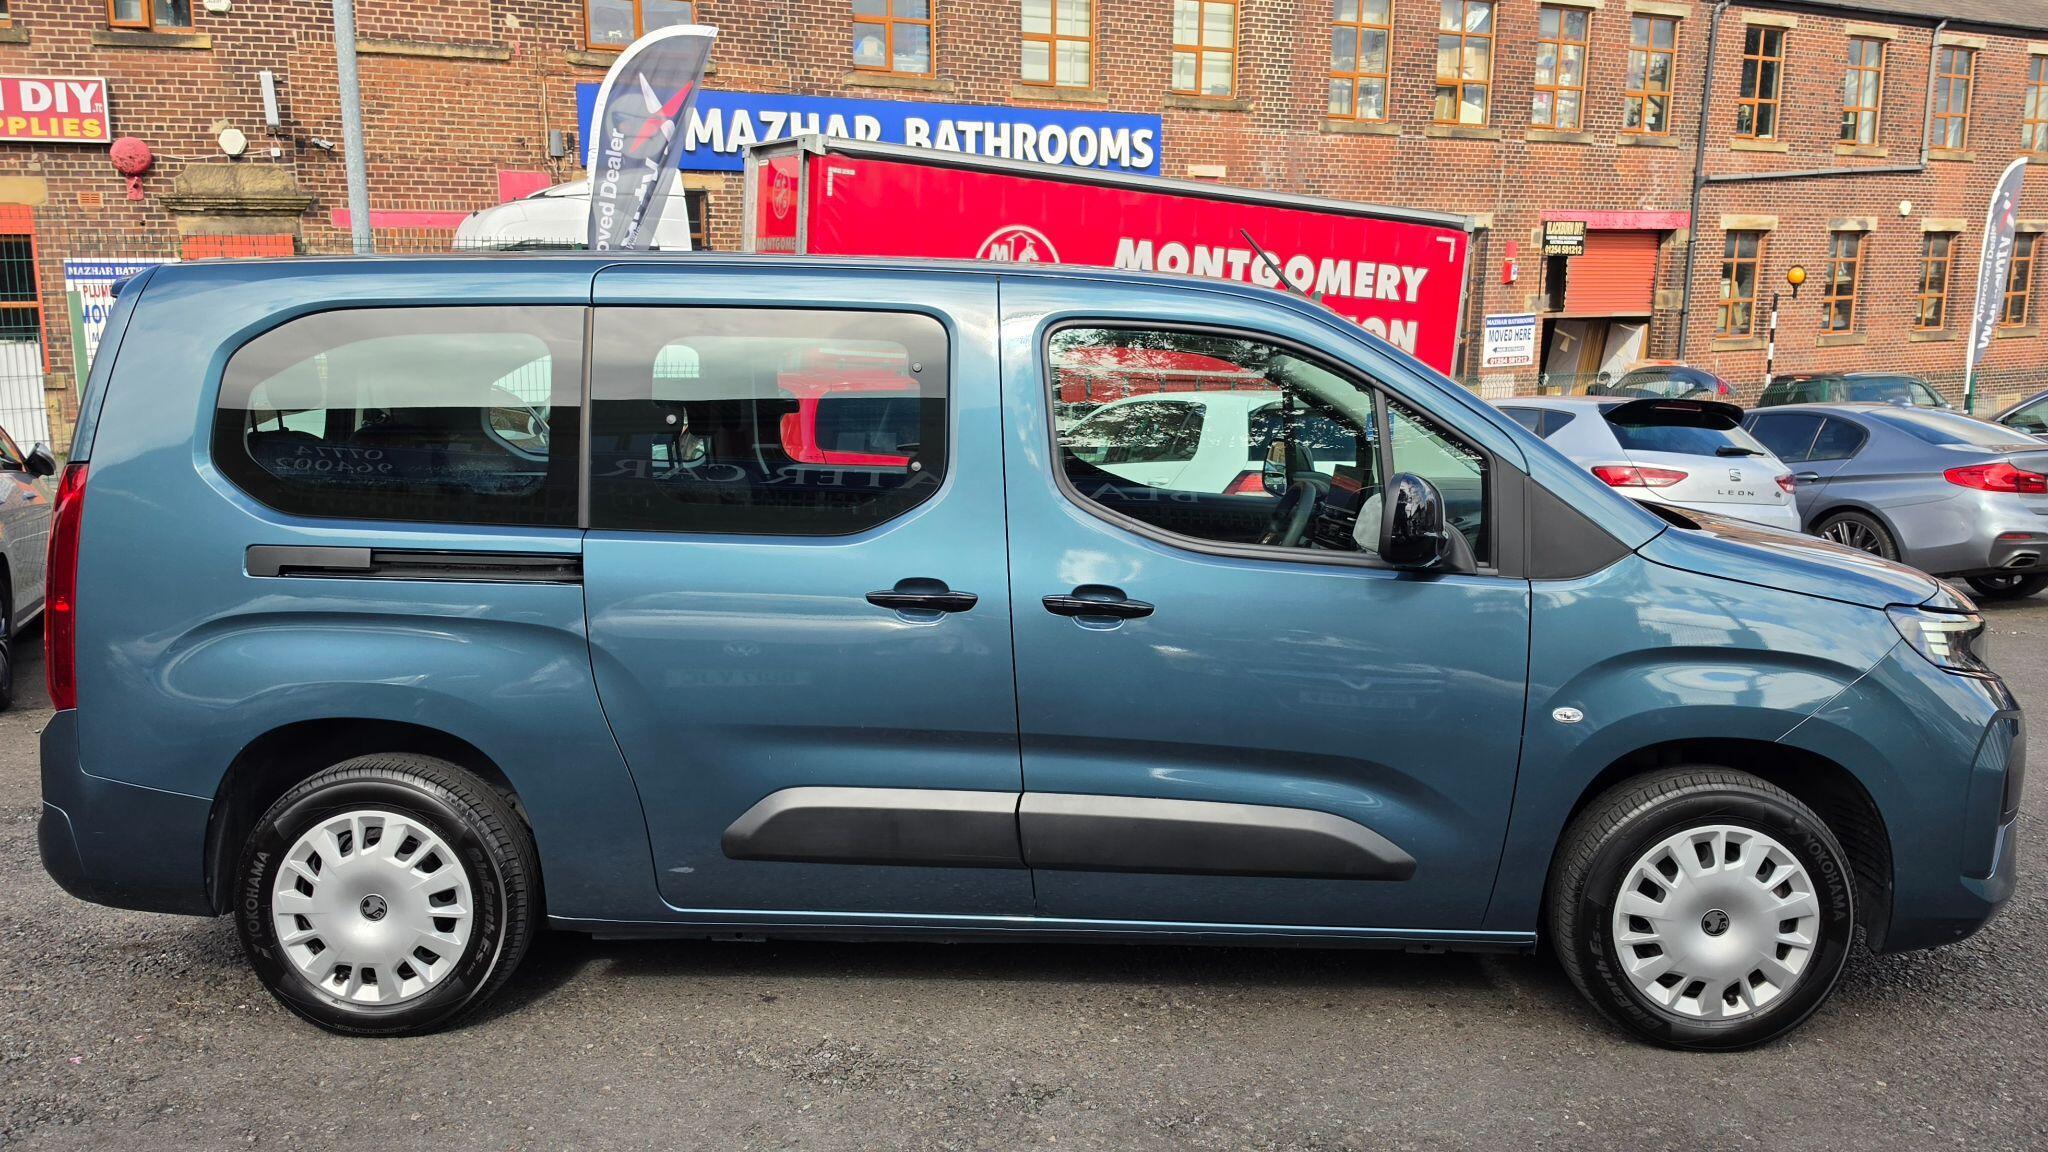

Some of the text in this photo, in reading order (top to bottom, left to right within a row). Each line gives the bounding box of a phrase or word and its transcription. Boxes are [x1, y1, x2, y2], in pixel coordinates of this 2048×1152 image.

[19, 80, 99, 113] DIY
[0, 116, 102, 138] PLIES
[904, 117, 1154, 169] BATHROOMS
[600, 128, 625, 199] Dealer
[67, 266, 114, 276] MAZHAR
[1113, 238, 1428, 303] MONTGOMERY
[1489, 328, 1531, 342] MOVED HERE
[1718, 489, 1755, 497] LEON
[246, 851, 271, 939] YOKOHAMA
[1803, 834, 1847, 921] YOKOHAMA
